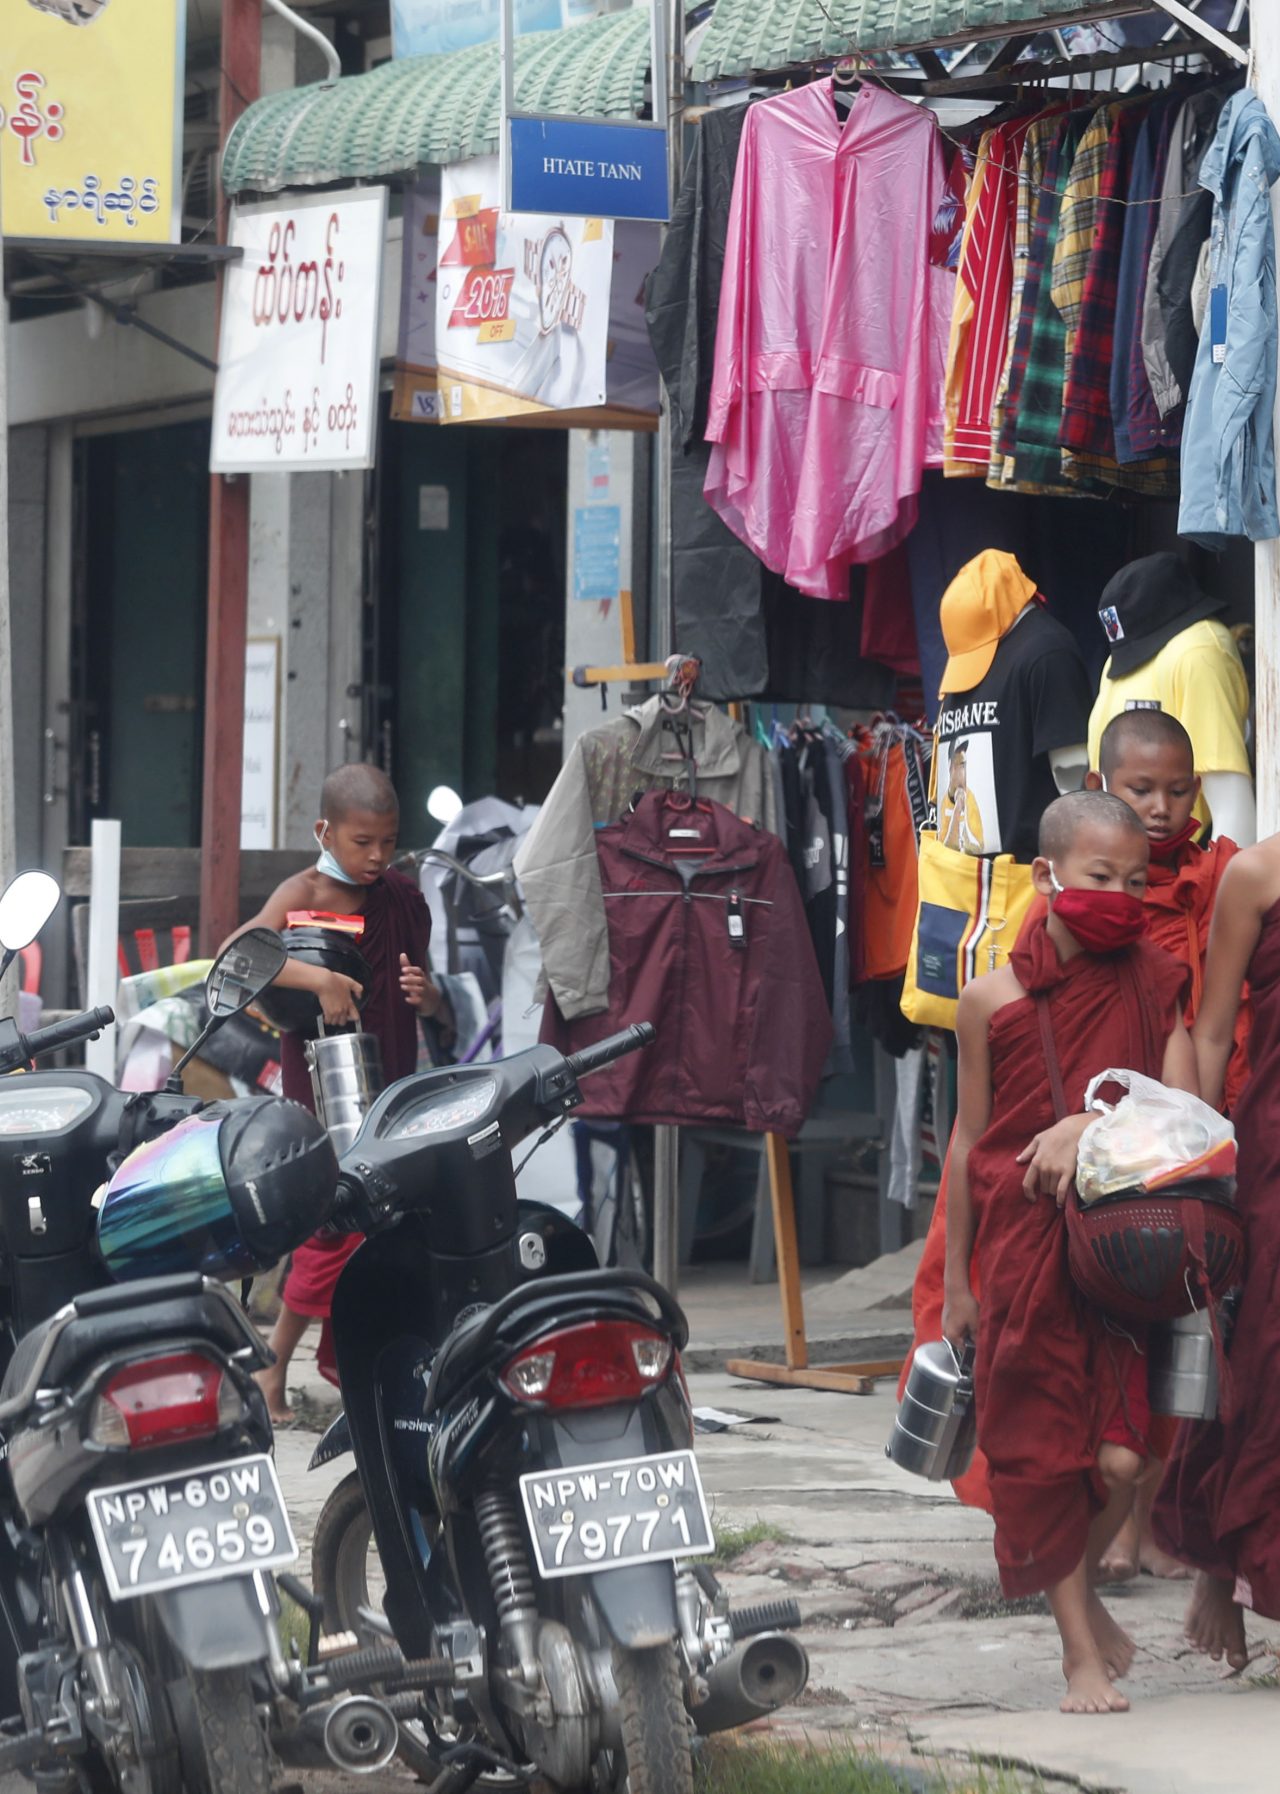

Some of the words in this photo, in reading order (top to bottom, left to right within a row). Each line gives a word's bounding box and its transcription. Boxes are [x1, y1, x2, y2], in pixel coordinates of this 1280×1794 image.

[543, 157, 594, 177] HTATE
[598, 162, 642, 181] TANN
[464, 223, 490, 254] SALE
[464, 275, 507, 319] 20%
[101, 1465, 260, 1526] NPW-60W
[533, 1461, 685, 1509] NPW-70W
[121, 1514, 276, 1584] 74659
[548, 1505, 691, 1566] 79771
